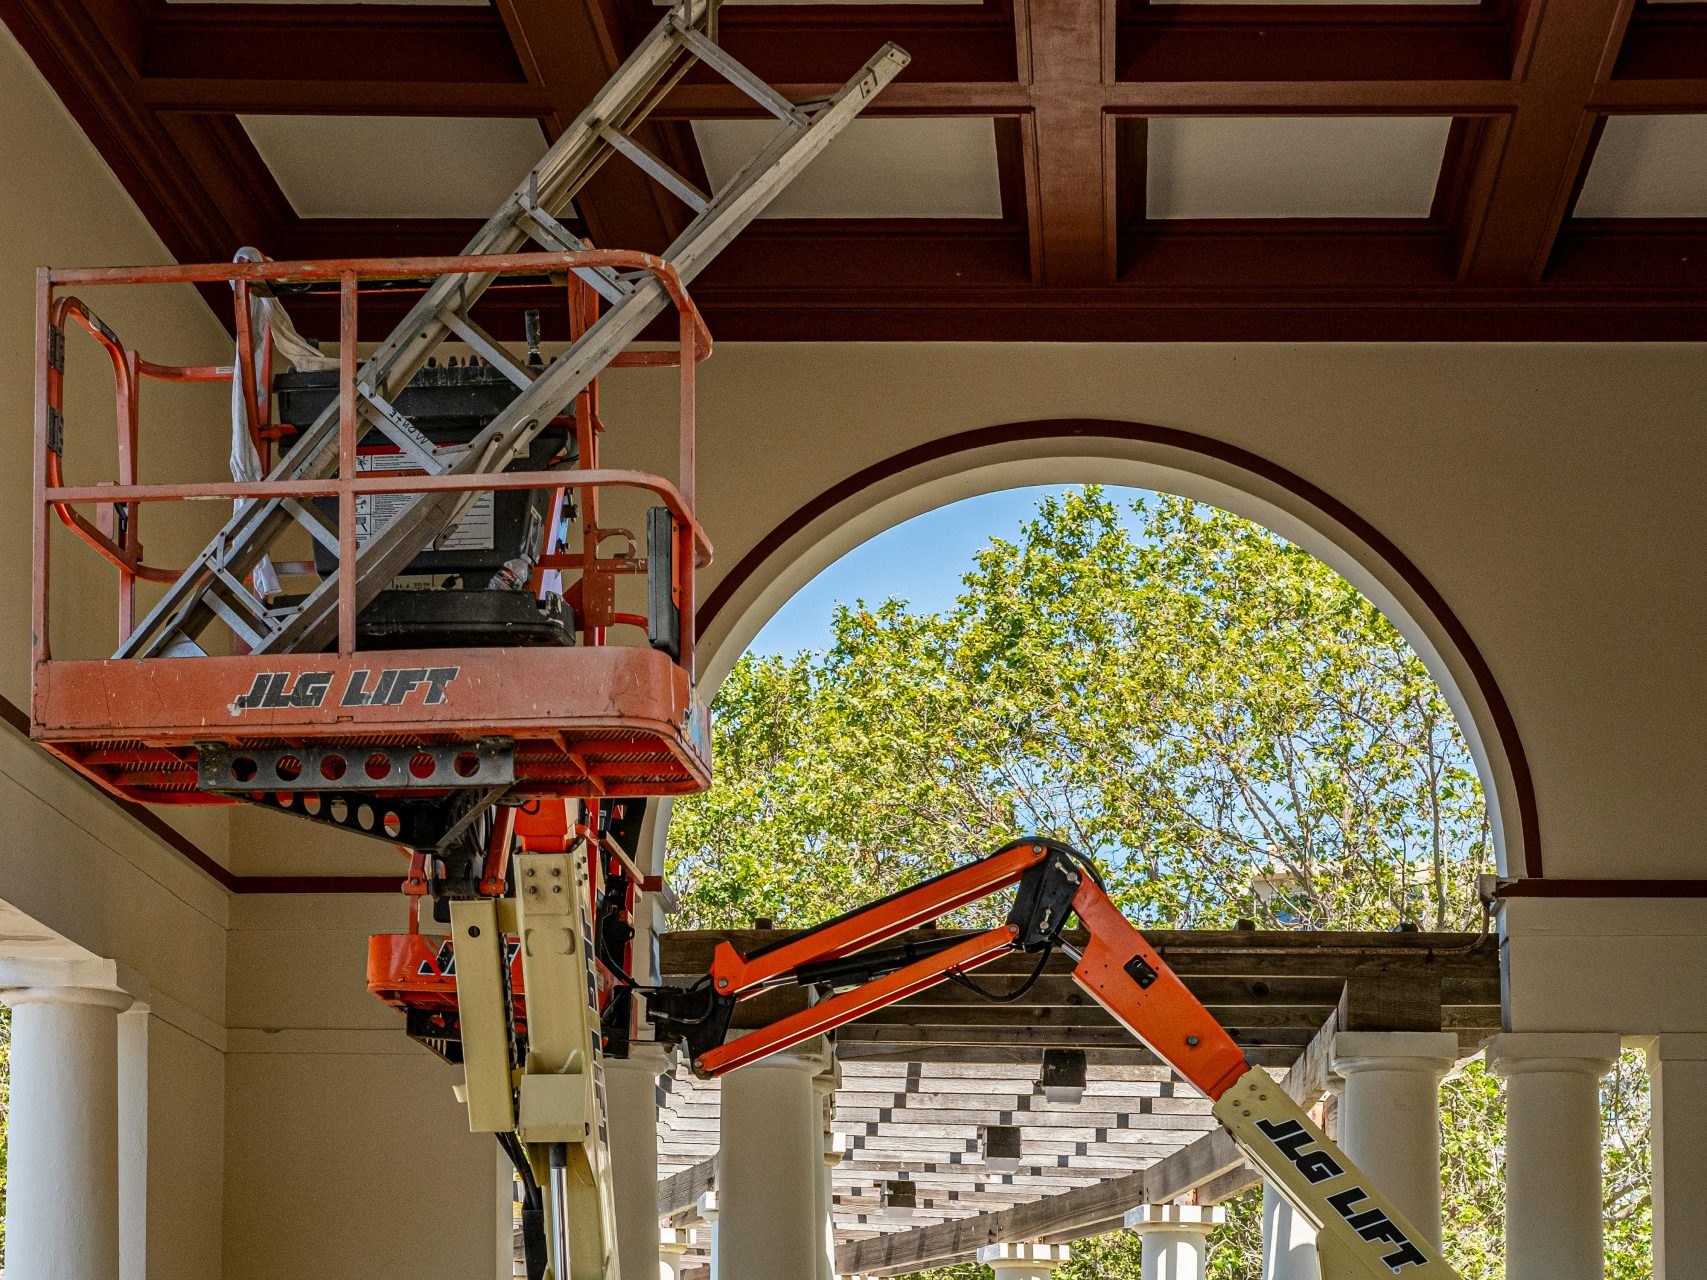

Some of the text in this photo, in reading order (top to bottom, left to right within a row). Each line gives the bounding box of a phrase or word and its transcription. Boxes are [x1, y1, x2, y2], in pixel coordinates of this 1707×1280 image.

[235, 666, 461, 710] JLG LIFT
[1253, 1116, 1431, 1270] JLG LIFT
